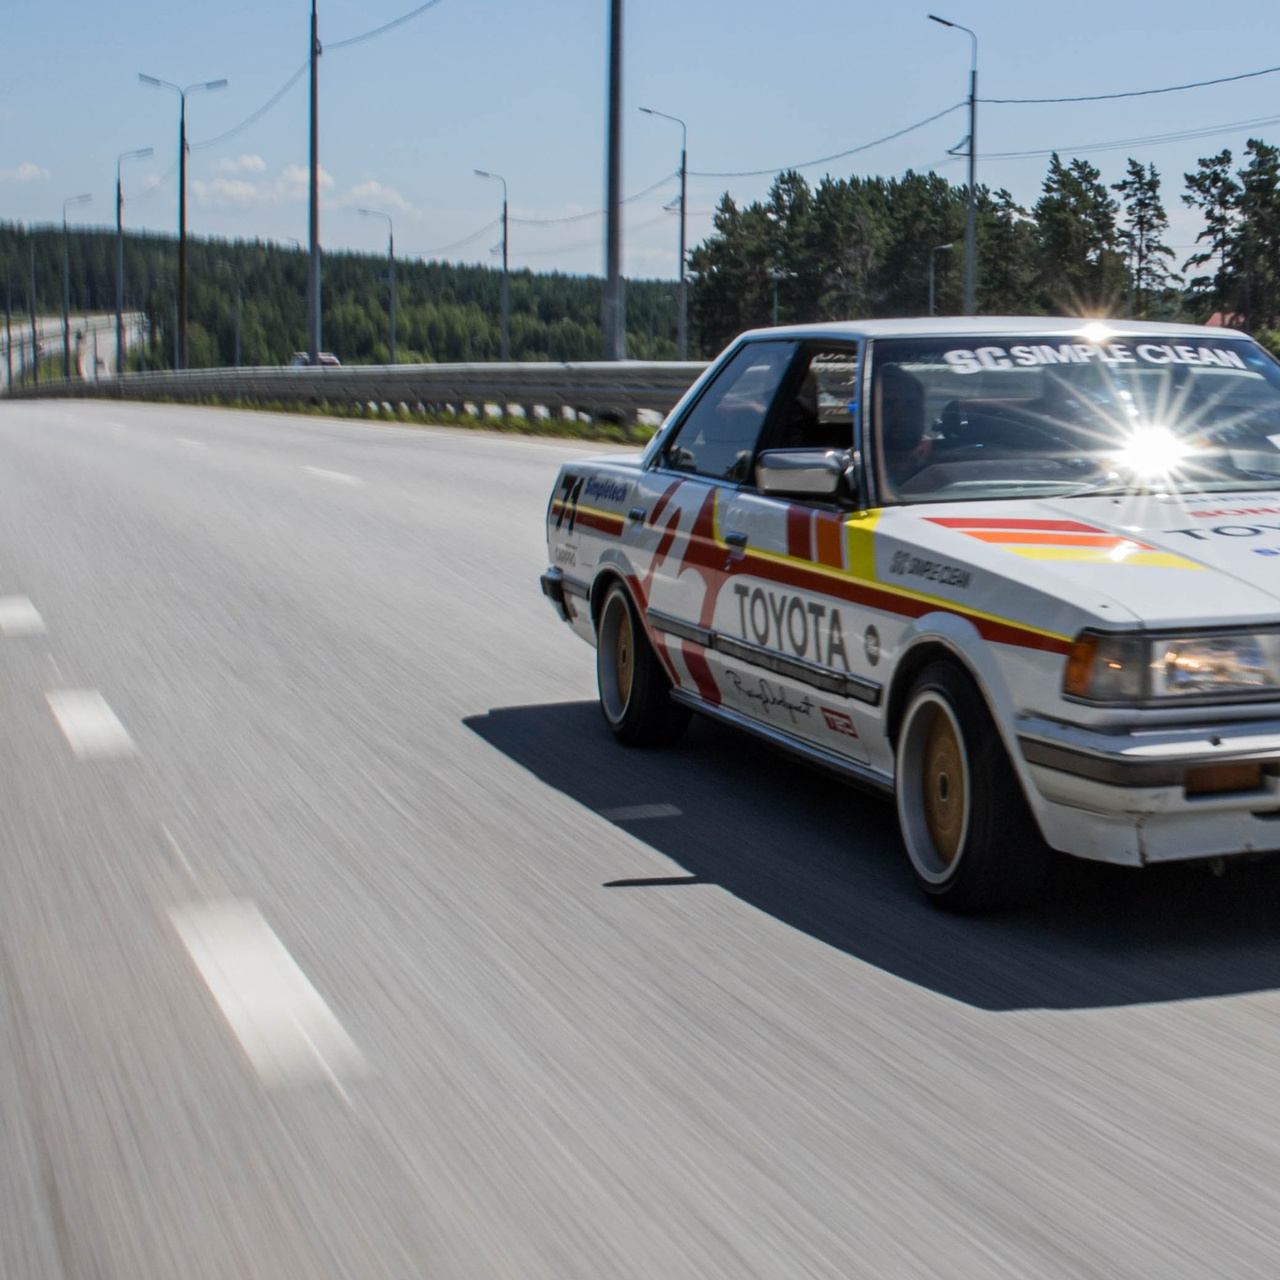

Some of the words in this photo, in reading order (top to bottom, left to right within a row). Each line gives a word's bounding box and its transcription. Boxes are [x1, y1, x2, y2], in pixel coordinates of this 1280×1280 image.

[943, 346, 1013, 375] SC
[1009, 344, 1137, 367] SIMPLE
[1136, 343, 1247, 370] CLEAN
[556, 473, 585, 536] 71
[734, 583, 852, 673] TOYOTA
